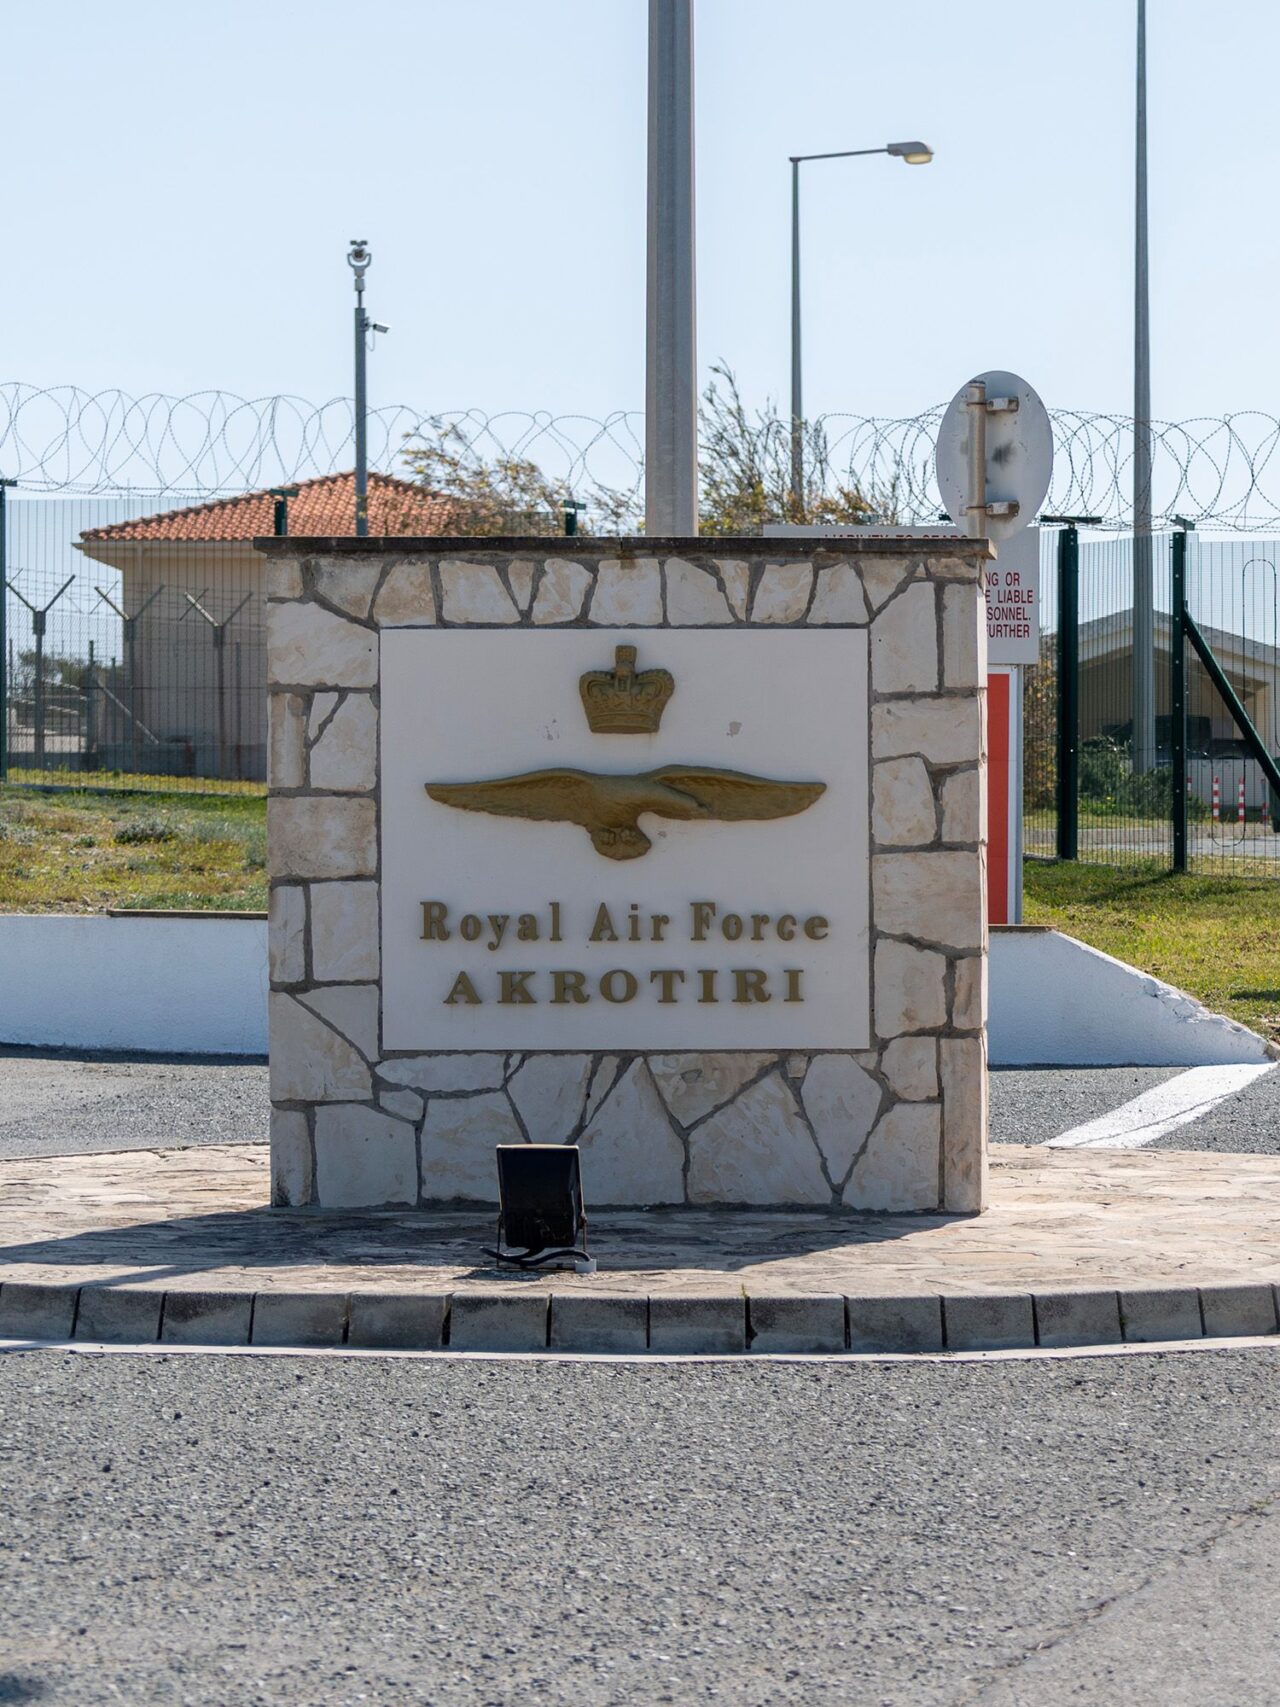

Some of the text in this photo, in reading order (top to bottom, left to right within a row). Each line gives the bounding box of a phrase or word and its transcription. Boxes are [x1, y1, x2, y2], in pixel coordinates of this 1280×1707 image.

[1005, 571, 1020, 587] OR
[997, 589, 1034, 604] LIABLE
[986, 606, 1031, 622] SONNEL.
[419, 900, 829, 952] Royal Air Force
[442, 968, 805, 1006] AKROTIRI
